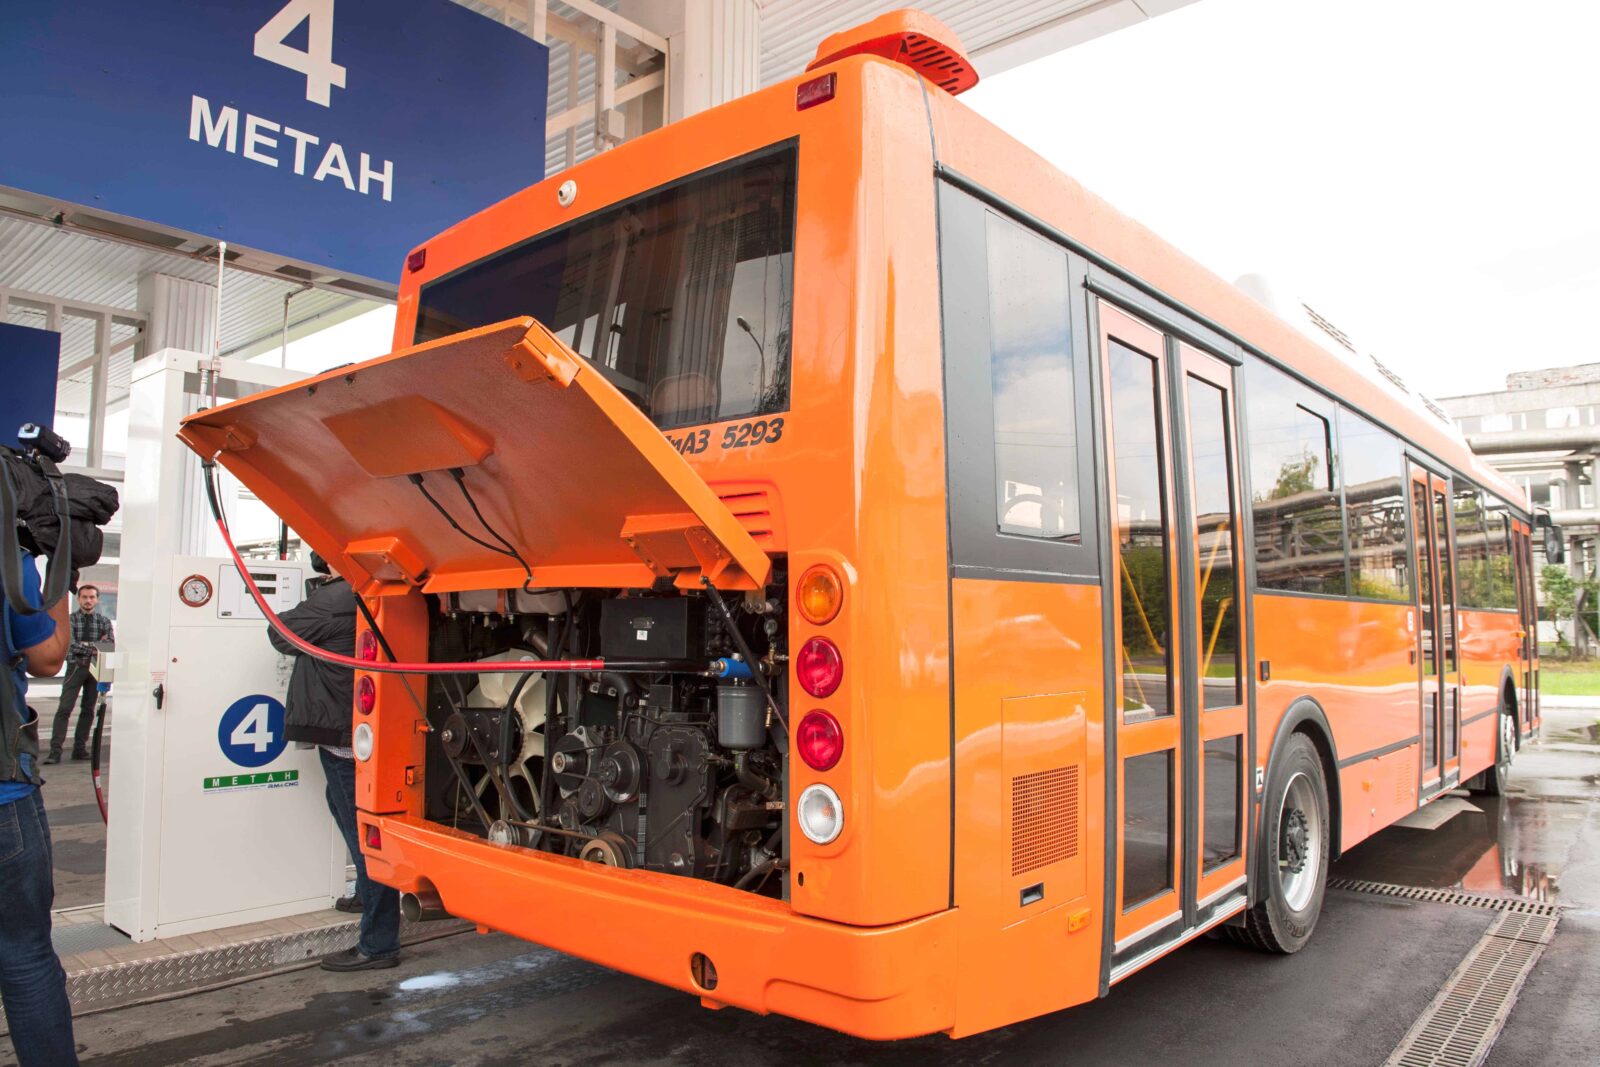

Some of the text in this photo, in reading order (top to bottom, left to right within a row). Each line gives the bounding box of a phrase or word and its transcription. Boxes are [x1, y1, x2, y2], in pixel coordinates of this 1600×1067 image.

[253, 0, 346, 108] 4
[189, 94, 393, 202] МЕТАН
[665, 417, 784, 455] иАЗ 5293
[230, 703, 273, 753] 4
[212, 772, 291, 787] МЕТАН
